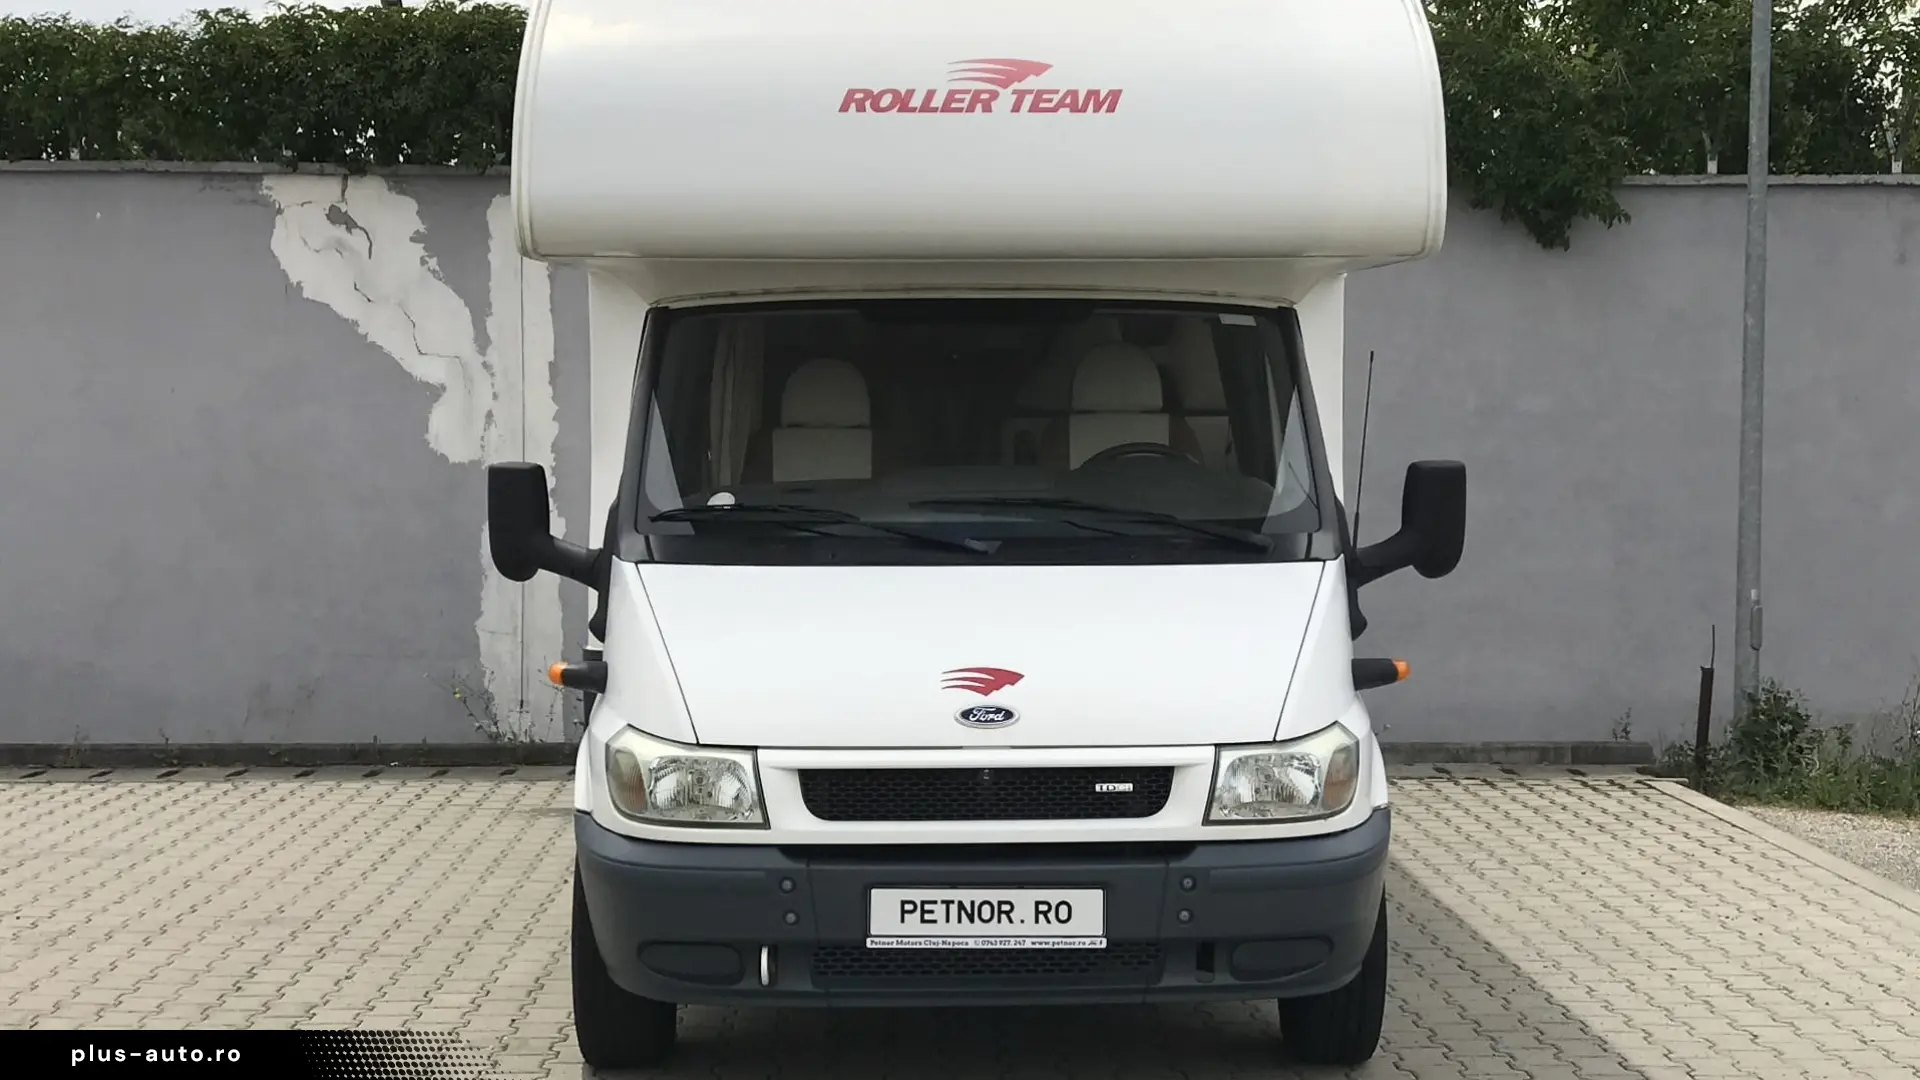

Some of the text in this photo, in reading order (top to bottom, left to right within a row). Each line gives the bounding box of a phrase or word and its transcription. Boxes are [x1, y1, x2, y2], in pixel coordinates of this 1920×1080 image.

[838, 88, 1123, 113] ROLLER TEAM
[969, 707, 1006, 722] Ford
[1031, 939, 1086, 947] www.petnor.ro
